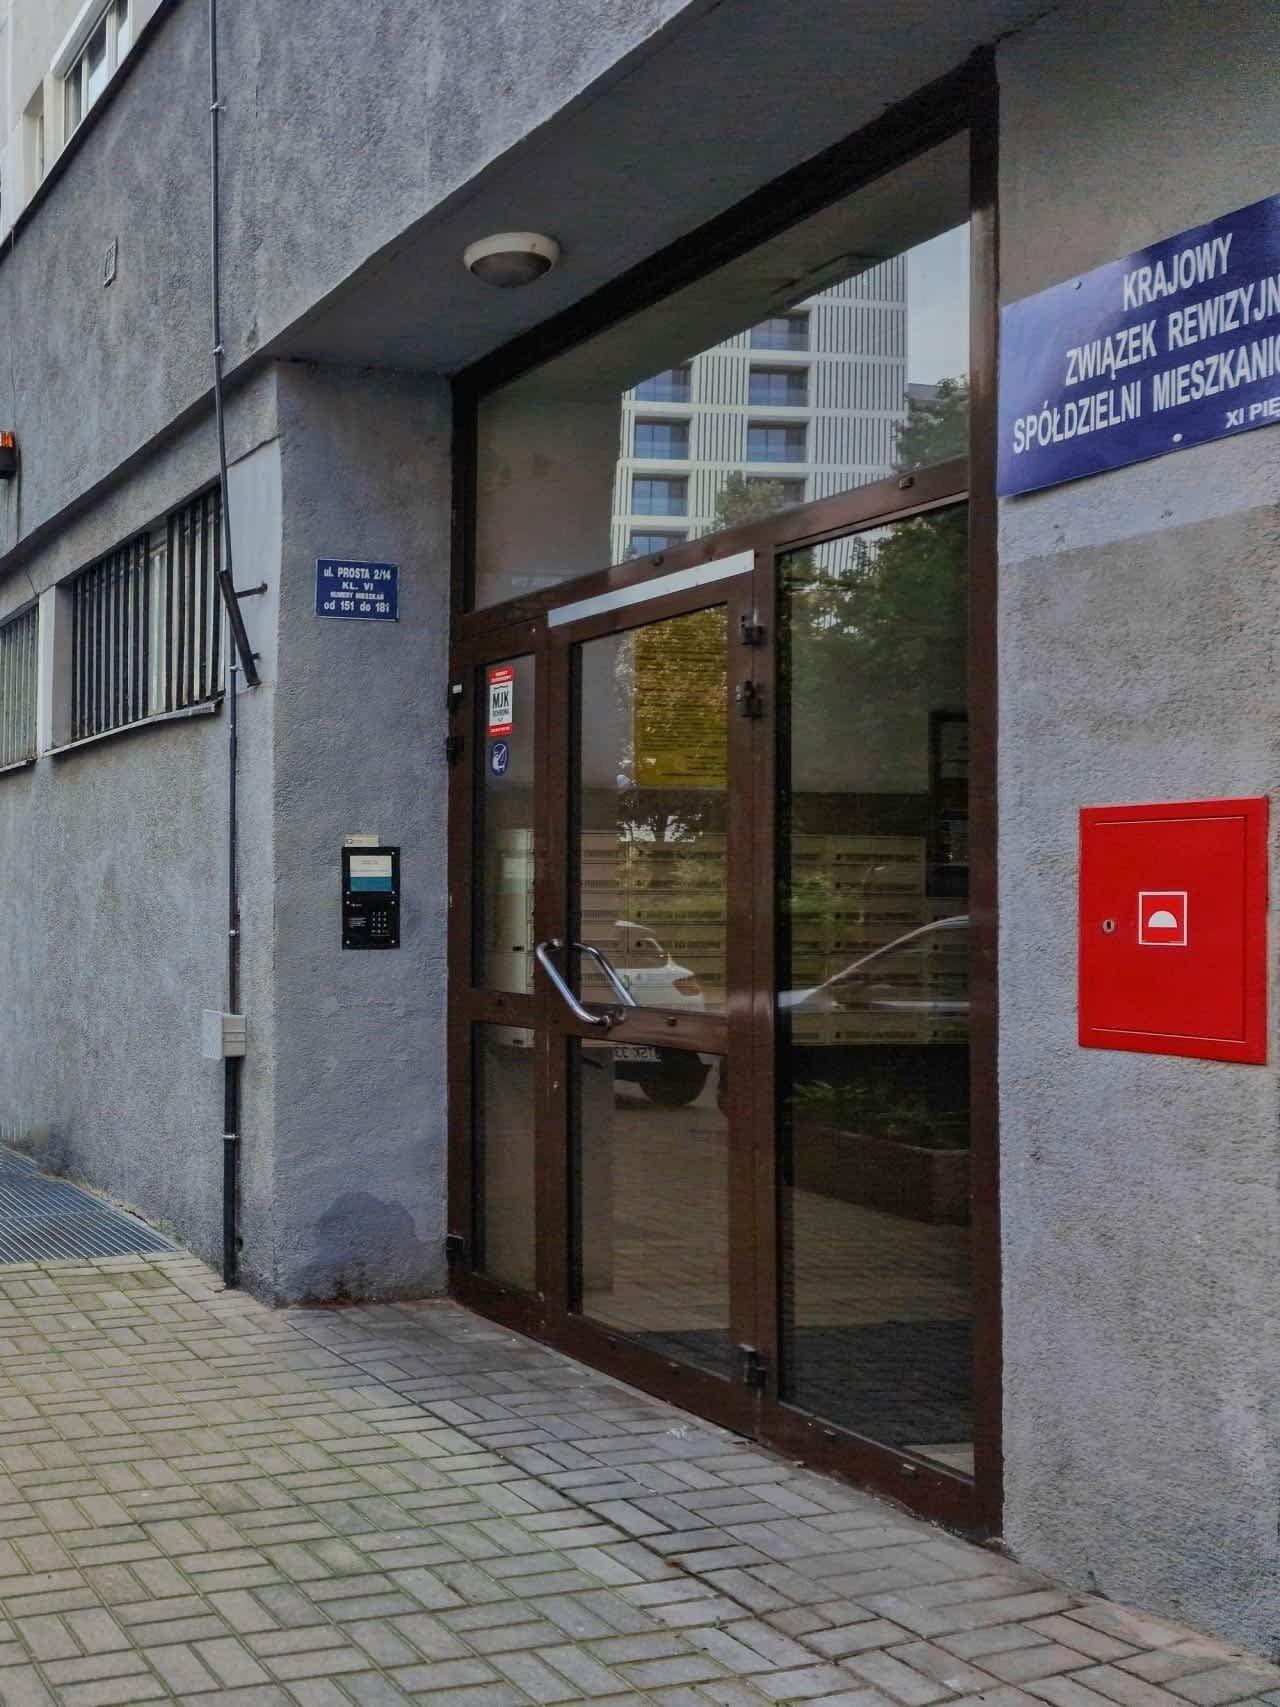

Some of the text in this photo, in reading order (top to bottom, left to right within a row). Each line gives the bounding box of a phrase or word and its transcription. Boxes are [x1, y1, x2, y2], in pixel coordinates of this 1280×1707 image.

[1123, 233, 1233, 311] KRAJOWY
[1065, 320, 1157, 386] ZWIĄZEK
[1013, 334, 1280, 454] SPÓŁDZIELNI MIESZKANI
[1224, 407, 1245, 430] XI
[323, 566, 391, 581] ul. PROSTA 2/14
[342, 582, 374, 591] KL. VI
[323, 600, 335, 610] od
[340, 601, 355, 611] 151
[360, 602, 371, 612] do
[492, 691, 510, 709] MJK
